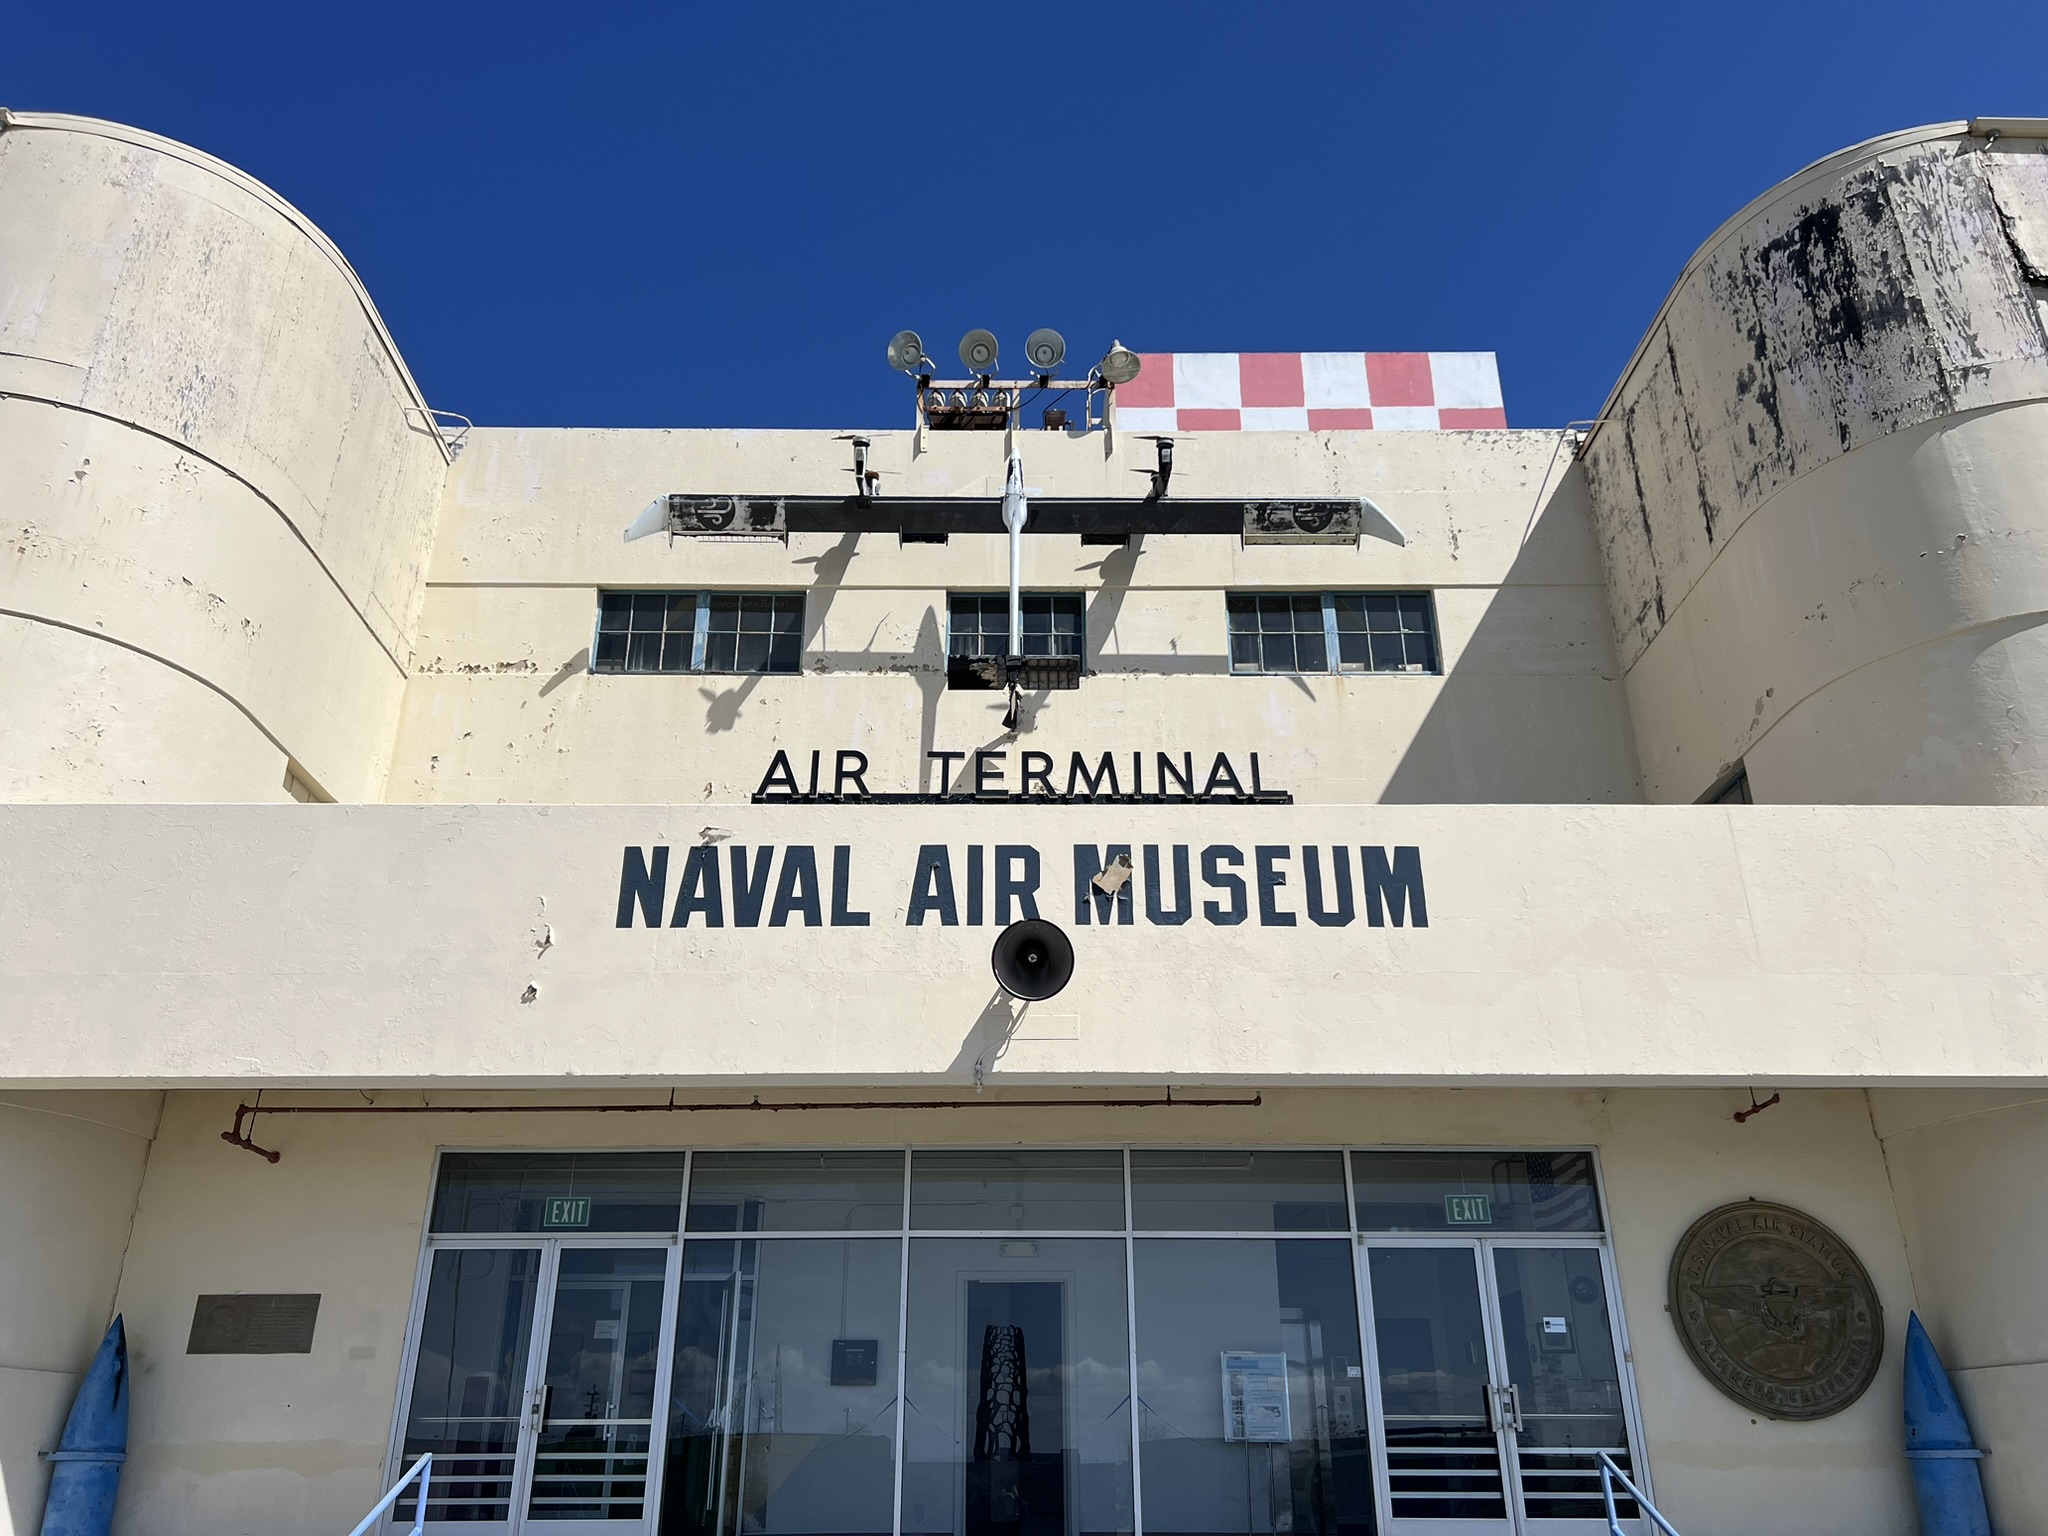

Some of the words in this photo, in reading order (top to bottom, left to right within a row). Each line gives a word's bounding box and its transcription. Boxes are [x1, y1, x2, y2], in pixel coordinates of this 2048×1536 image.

[755, 749, 872, 799] AIR
[927, 750, 1289, 800] TERMINAL
[615, 846, 869, 927] NAVAL
[908, 845, 1041, 926] AIR
[1075, 845, 1429, 927] MUSEUM
[551, 1200, 586, 1223] EXIT
[1452, 1198, 1485, 1221] EXIT
[1753, 1215, 1783, 1231] AIR
[1789, 1224, 1853, 1281] STATION
[1788, 1338, 1870, 1405] CALIFORNIA
